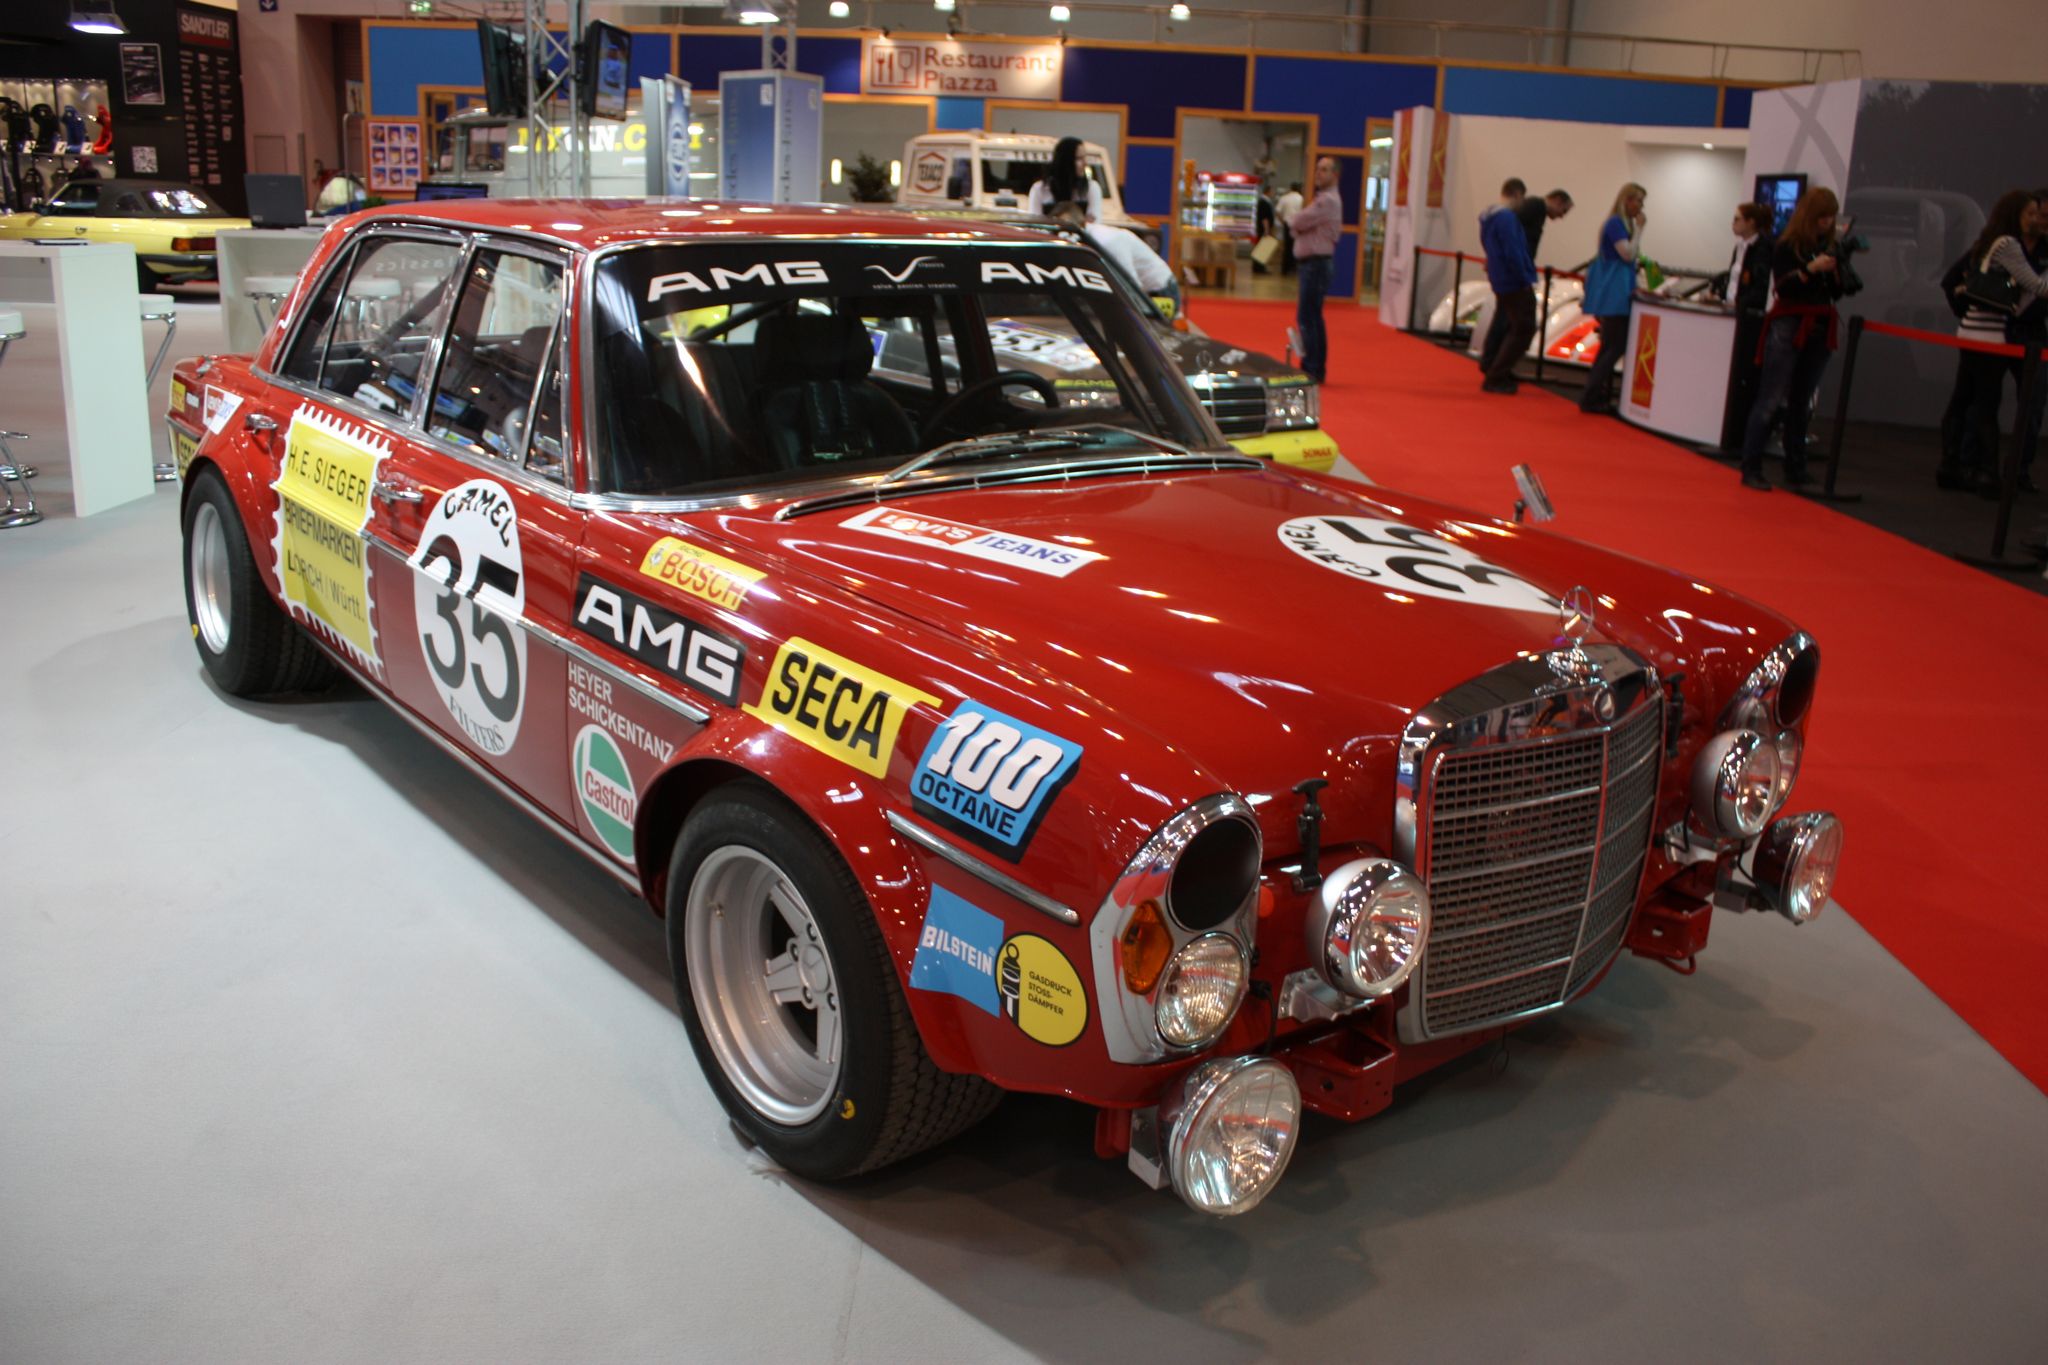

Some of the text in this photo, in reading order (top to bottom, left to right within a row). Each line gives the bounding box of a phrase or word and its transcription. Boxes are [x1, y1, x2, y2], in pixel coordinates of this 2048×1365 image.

[924, 46, 1055, 72] Restaurant
[924, 70, 998, 92] Piazza
[647, 261, 829, 302] AMG
[981, 262, 1114, 293] AMG
[287, 443, 367, 509] H.E. SIEGER
[284, 497, 362, 568] BRIEFMARKEN
[444, 487, 514, 548] CAMEL
[287, 549, 324, 593] LORCH
[975, 535, 1080, 564] JEANS
[1284, 523, 1382, 578] CAMEL
[660, 551, 747, 607] BOSCH
[419, 534, 520, 723] 35
[577, 585, 738, 697] AMG
[568, 660, 613, 704] HEYER
[771, 651, 893, 760] SECA
[449, 695, 506, 753] FILTERS
[568, 687, 675, 764] SCHICKENTANZ
[926, 711, 1064, 811] 100
[585, 769, 635, 826] Castrol
[918, 772, 1017, 838] OCTANE
[921, 925, 993, 976] BILSTEIN
[1028, 992, 1064, 1017] DÄMPFER
[1029, 970, 1072, 998] GASDRUCK
